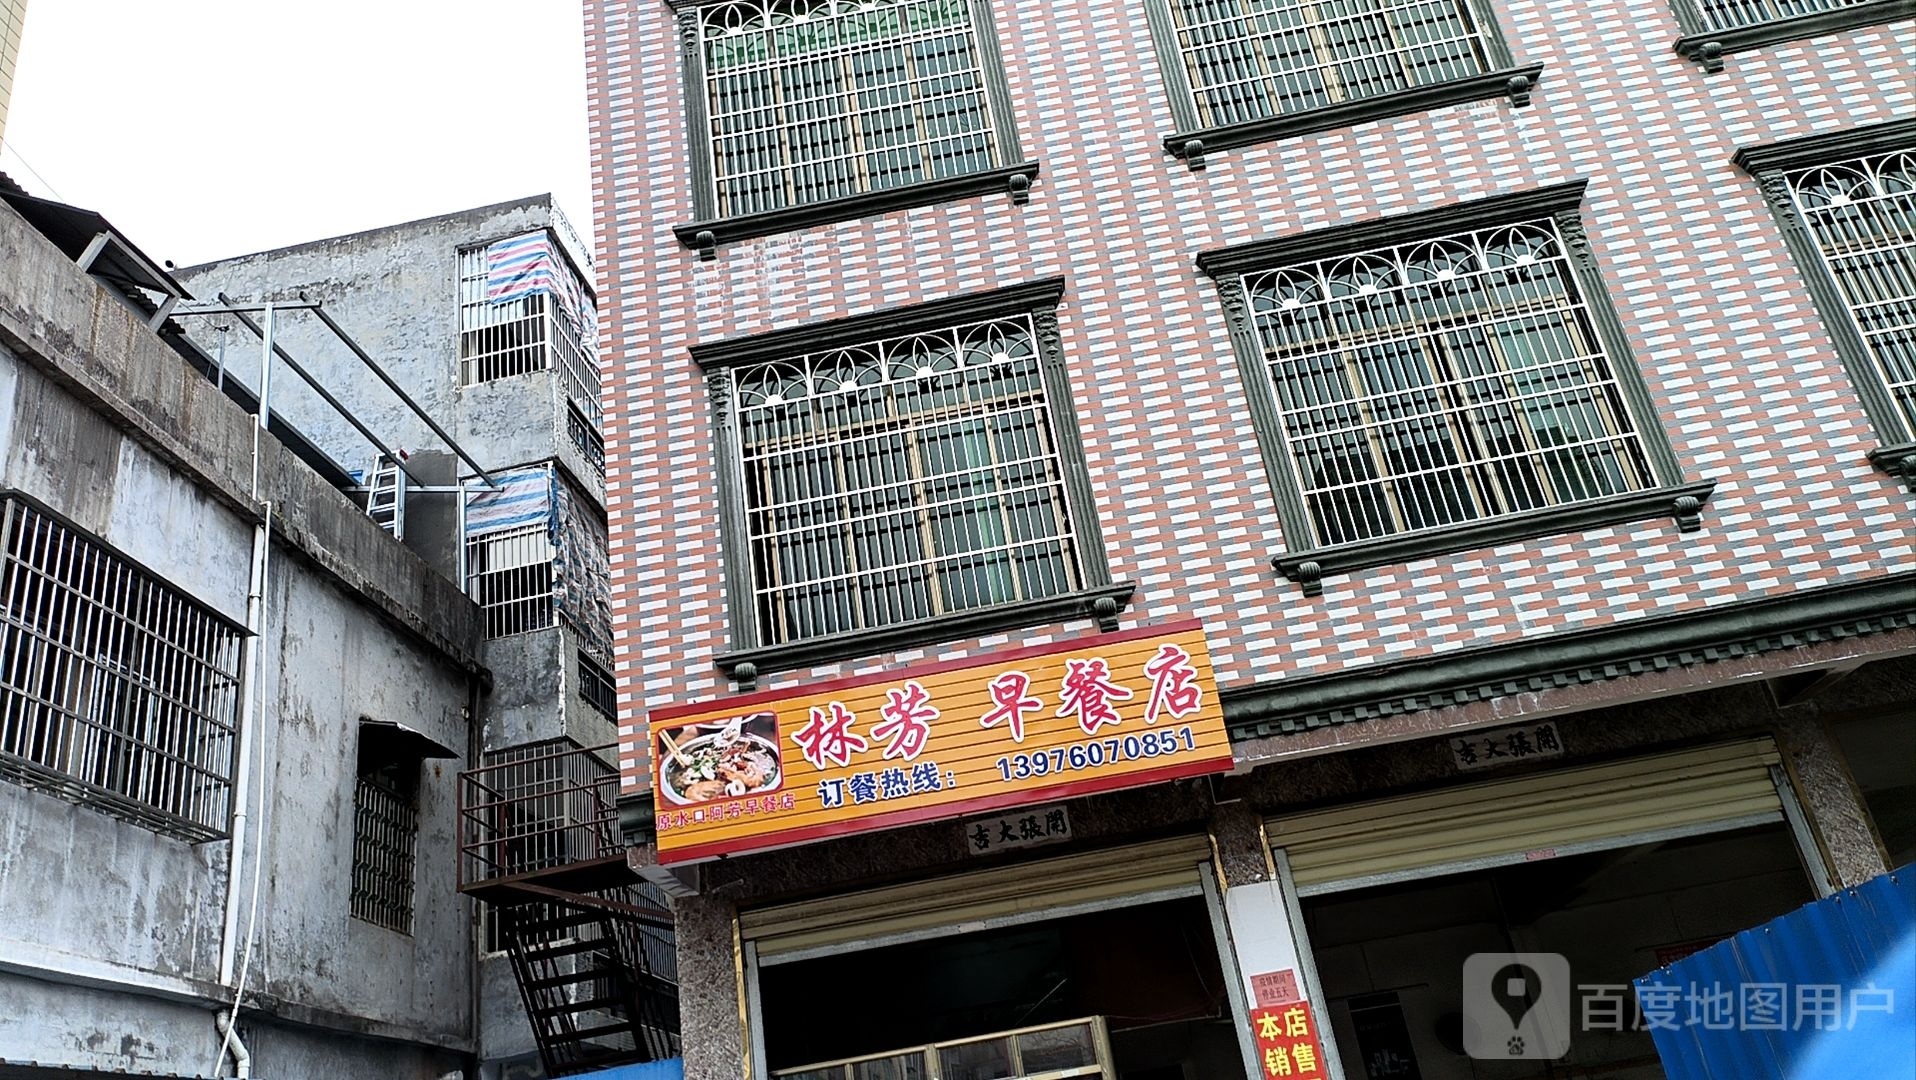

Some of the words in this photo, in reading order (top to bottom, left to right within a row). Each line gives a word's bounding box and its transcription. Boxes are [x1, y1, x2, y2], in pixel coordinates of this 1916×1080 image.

[792, 683, 941, 769] 林芳
[979, 643, 1203, 742] 早餐店
[996, 726, 1197, 783] 13976070851
[656, 793, 795, 831] 原水口阿芳早餐店
[1257, 1008, 1309, 1042] 本店
[1265, 1043, 1317, 1077] 销售
